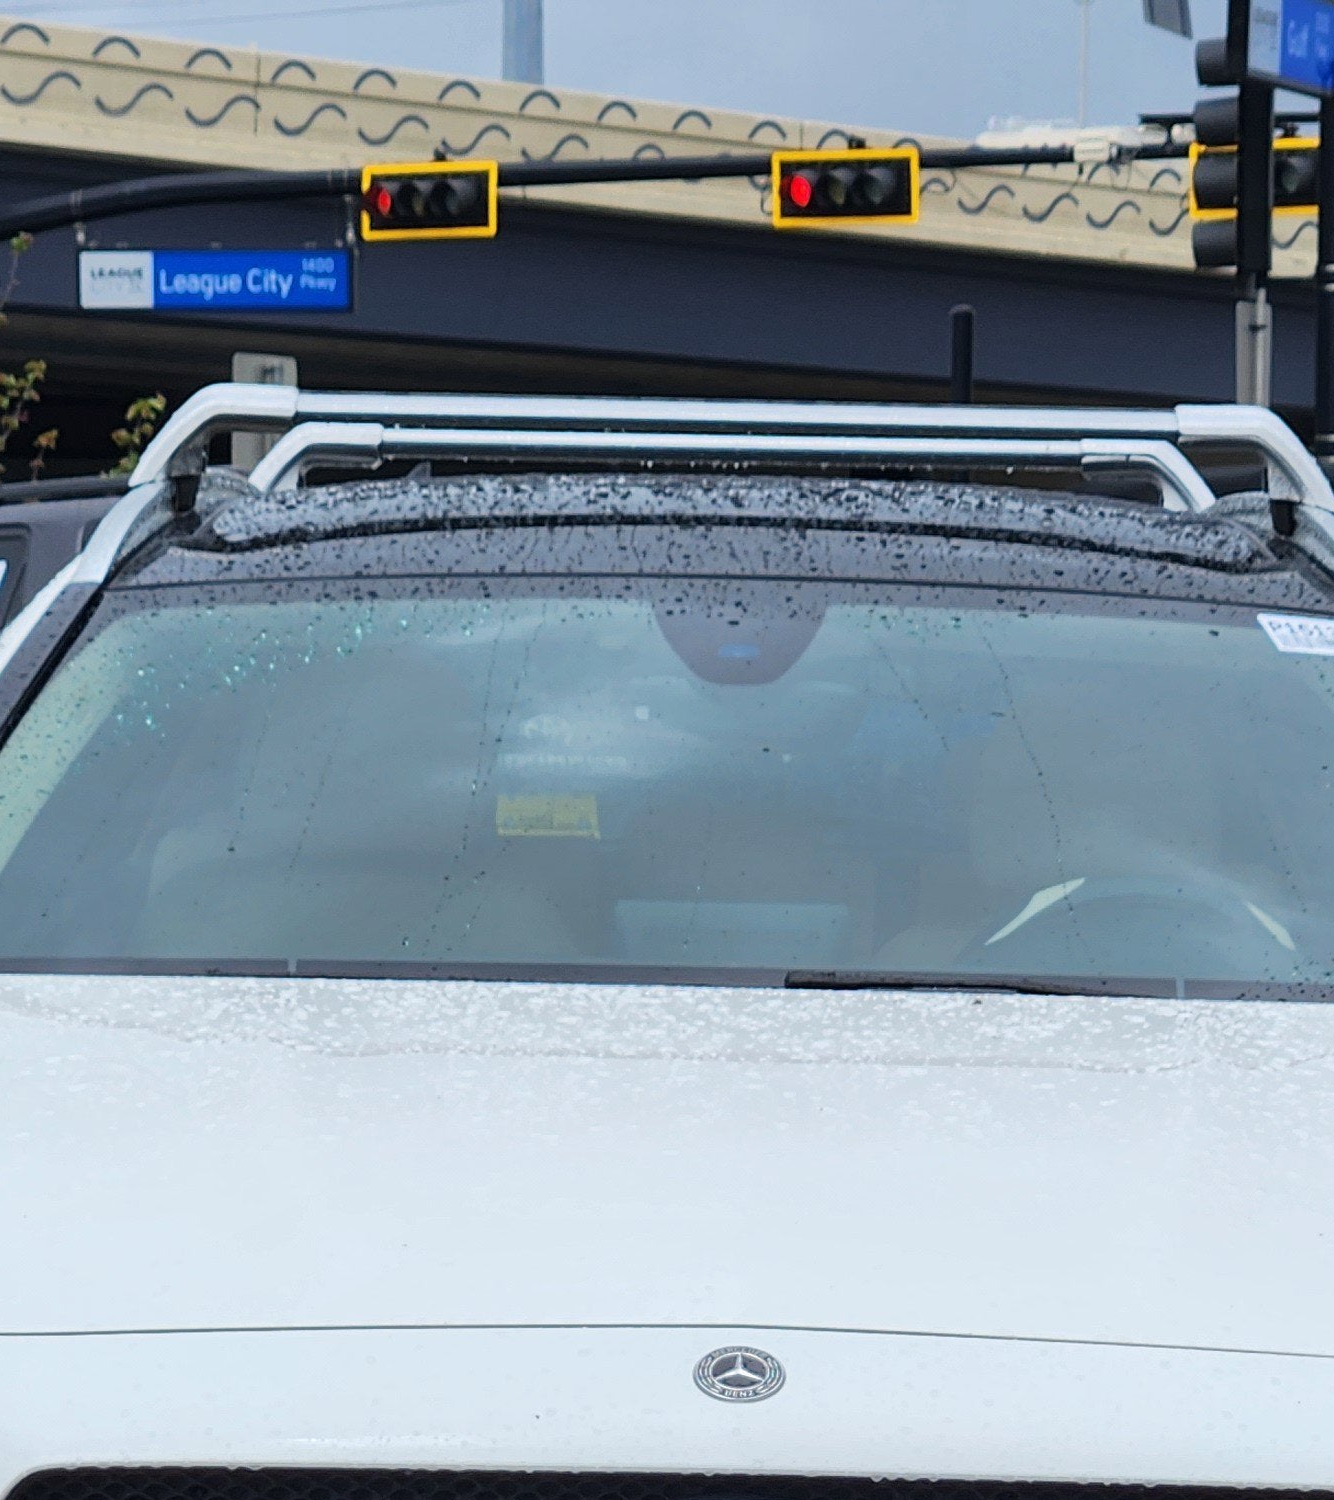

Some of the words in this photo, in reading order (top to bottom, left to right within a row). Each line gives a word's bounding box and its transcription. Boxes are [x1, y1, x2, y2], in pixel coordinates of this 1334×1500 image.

[90, 267, 144, 280] LEAGUE
[159, 268, 243, 301] League
[246, 267, 294, 299] City
